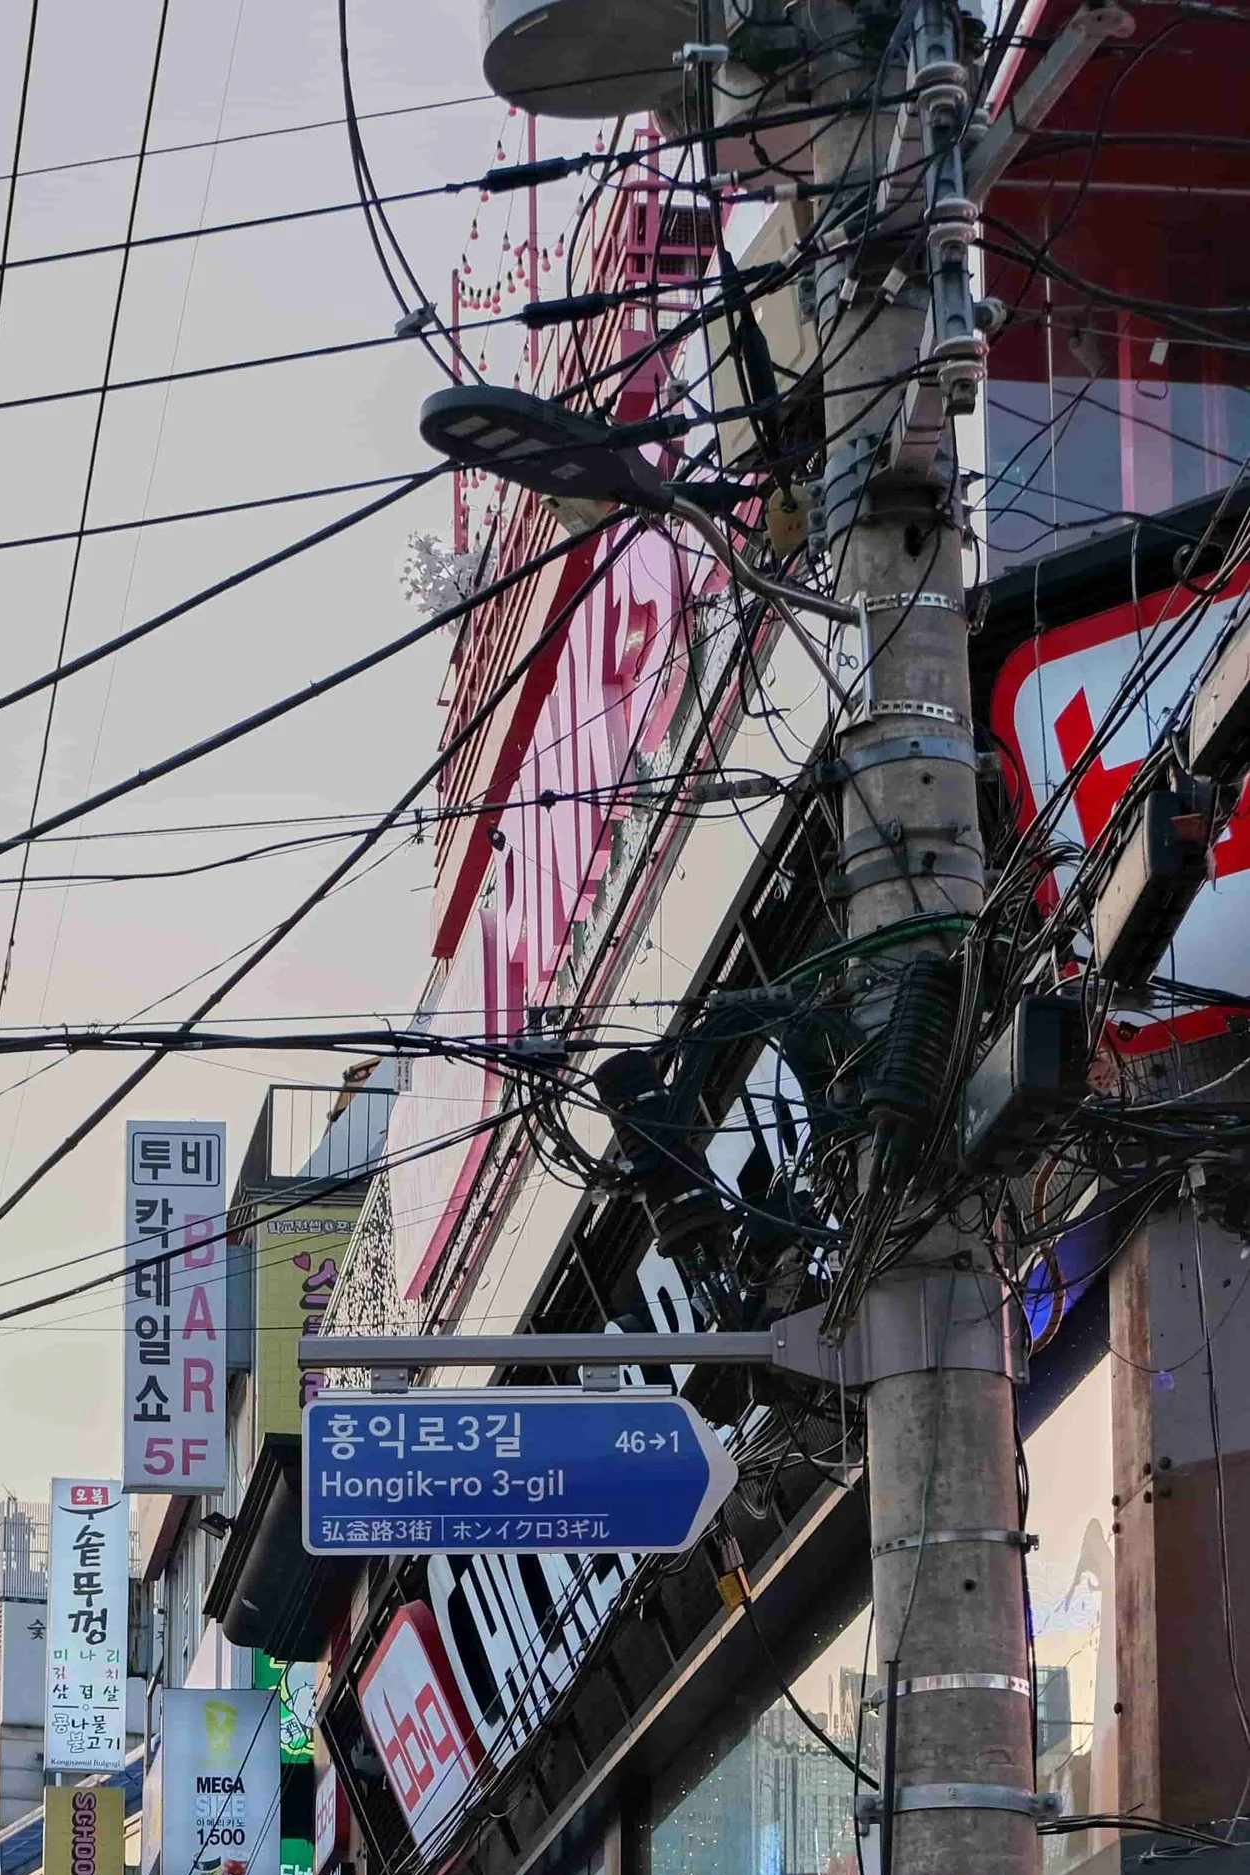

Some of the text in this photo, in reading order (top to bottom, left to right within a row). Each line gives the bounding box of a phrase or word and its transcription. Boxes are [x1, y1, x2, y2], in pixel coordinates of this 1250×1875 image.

[139, 1139, 212, 1182] 투비
[133, 1198, 174, 1422] 칵테일쇼
[182, 1213, 217, 1414] BAR
[321, 1412, 522, 1460] 홍익로3길
[142, 1437, 209, 1477] 5F
[321, 1469, 565, 1503] Hongik-ro 3-gil
[321, 1518, 610, 1542] 弘益路3街 ホンイクロ3ギル
[52, 1649, 121, 1663] 미나리
[52, 1683, 120, 1702] 삼겹살
[52, 1712, 108, 1735] 콩나물
[66, 1731, 121, 1754] 불고기
[196, 1777, 246, 1793] MEGA
[195, 1795, 246, 1817] SIZE
